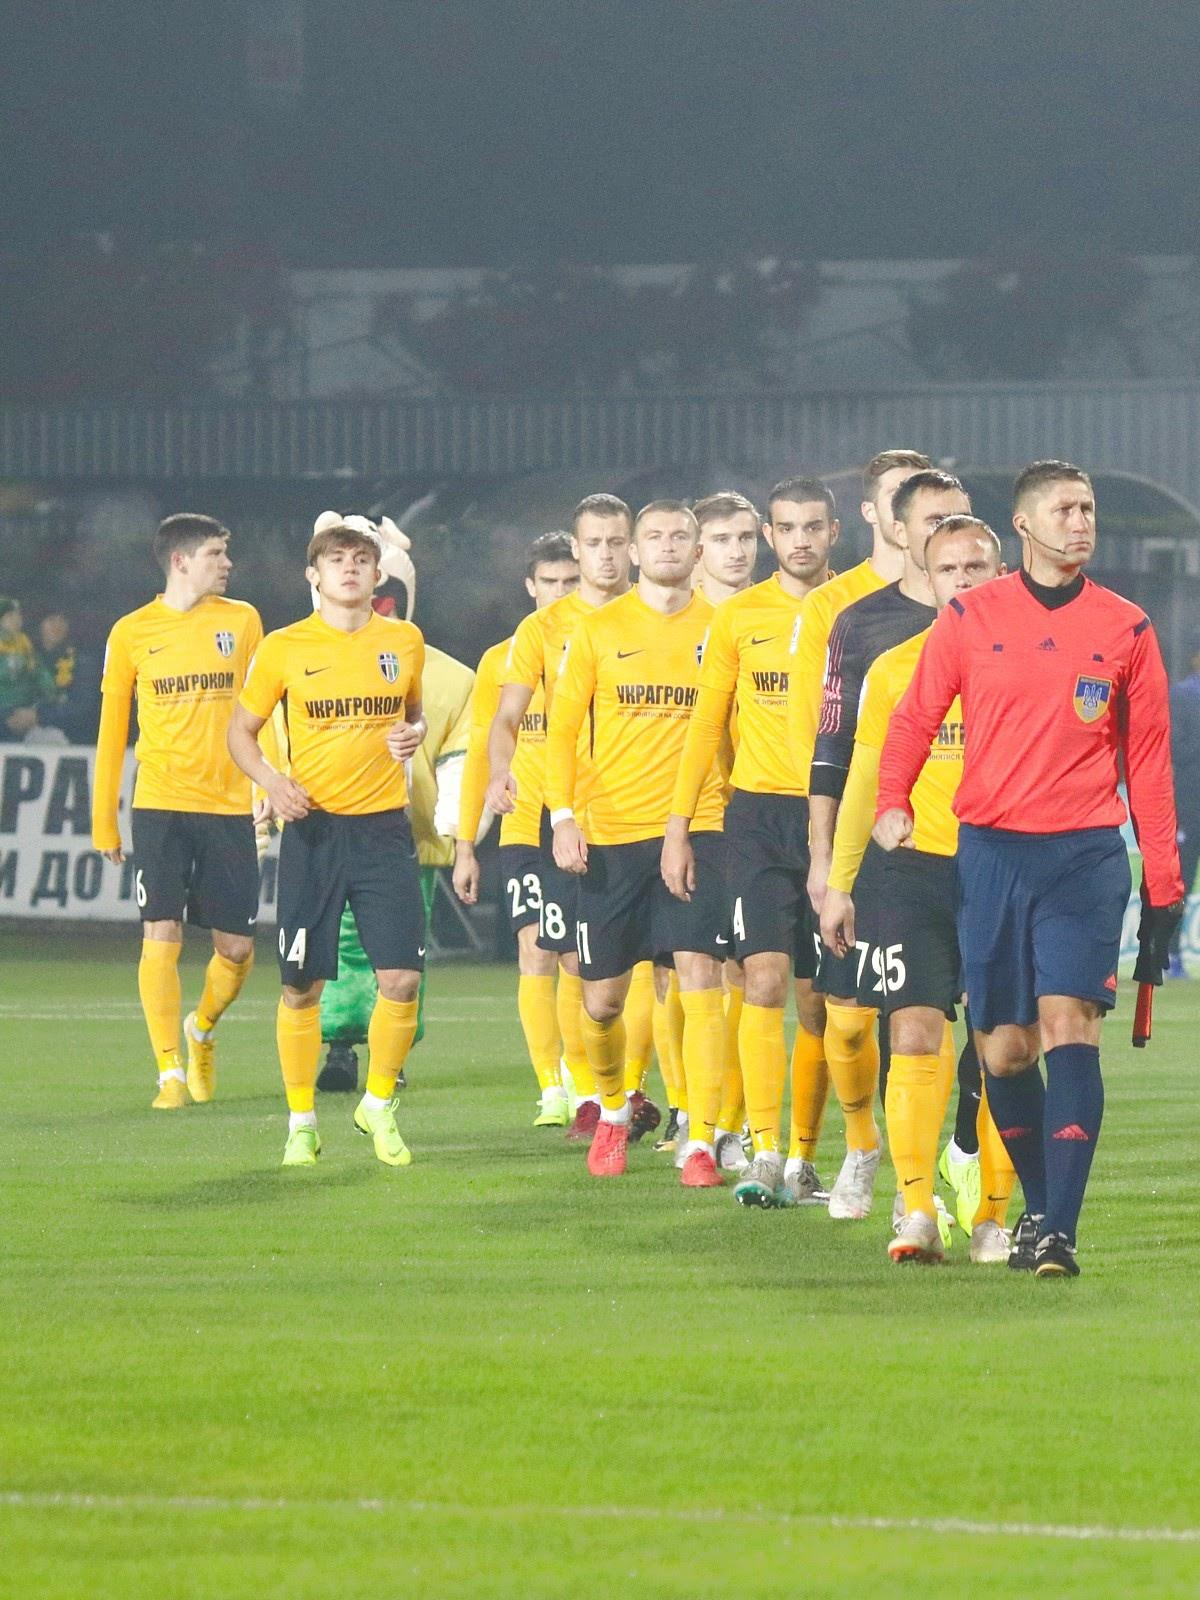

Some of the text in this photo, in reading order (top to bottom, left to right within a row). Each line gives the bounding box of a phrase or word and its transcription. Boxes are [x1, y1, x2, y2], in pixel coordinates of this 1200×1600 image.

[152, 672, 234, 695] УКРАГРОКОМ
[305, 696, 402, 718] УКРАГРОКОМ
[616, 685, 698, 707] УКРАГРОК
[507, 873, 542, 918] 23
[539, 900, 567, 940] 18
